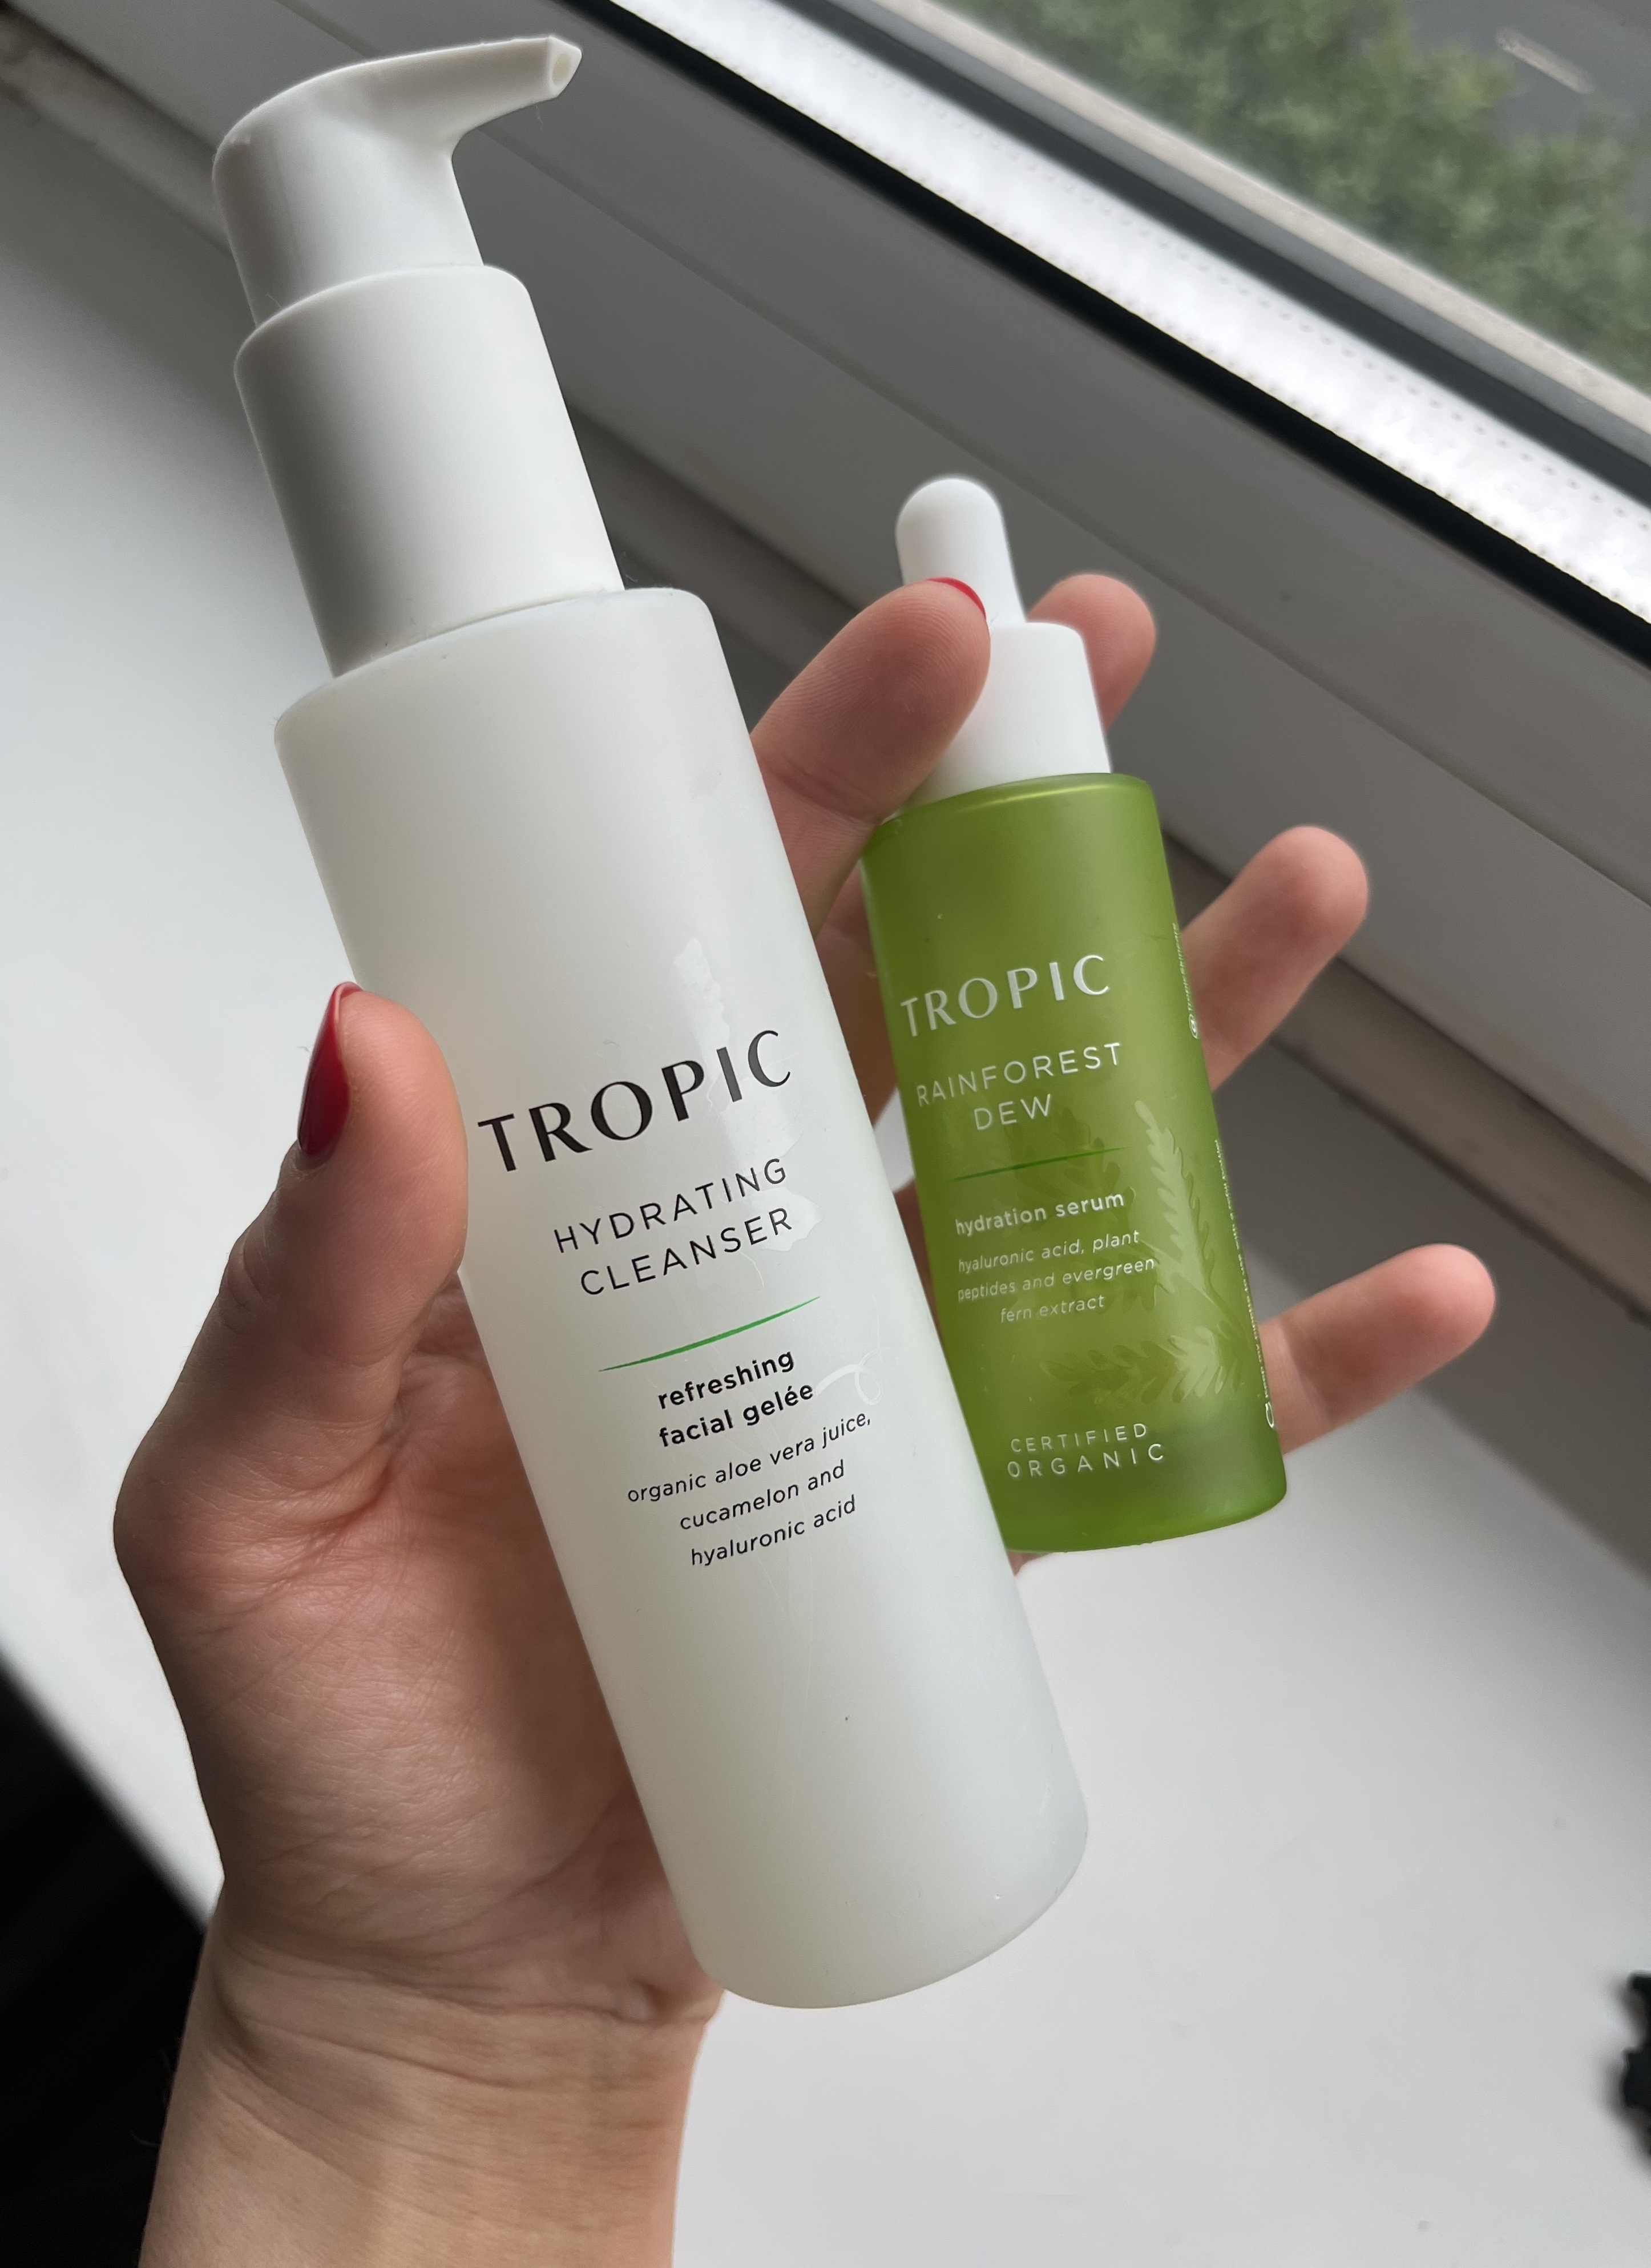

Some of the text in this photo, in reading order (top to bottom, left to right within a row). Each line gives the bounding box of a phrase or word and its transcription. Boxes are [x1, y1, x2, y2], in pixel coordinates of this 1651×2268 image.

[901, 955, 1109, 1036] TROPIC
[478, 1030, 790, 1171] TROPIC
[916, 1043, 1120, 1107] RAINFOREST
[975, 1094, 1051, 1129] DEW
[554, 1159, 785, 1253] HYDRATING
[956, 1194, 1124, 1236] hydration serum
[581, 1208, 792, 1294] CLEANSER
[958, 1258, 1156, 1301] peptides and evergreen
[959, 1230, 1139, 1274] hyaluronic acid, plant
[1000, 1295, 1104, 1323] fern extract
[659, 1352, 794, 1409] refreshing
[660, 1385, 813, 1447] facial gelée
[1011, 1423, 1147, 1452] CERTIFIED
[628, 1414, 870, 1502] organic aloe vera juice,
[1008, 1443, 1163, 1478] ORGANIC
[680, 1459, 843, 1530] cucamelon and
[692, 1494, 855, 1566] hyaluronic acid
